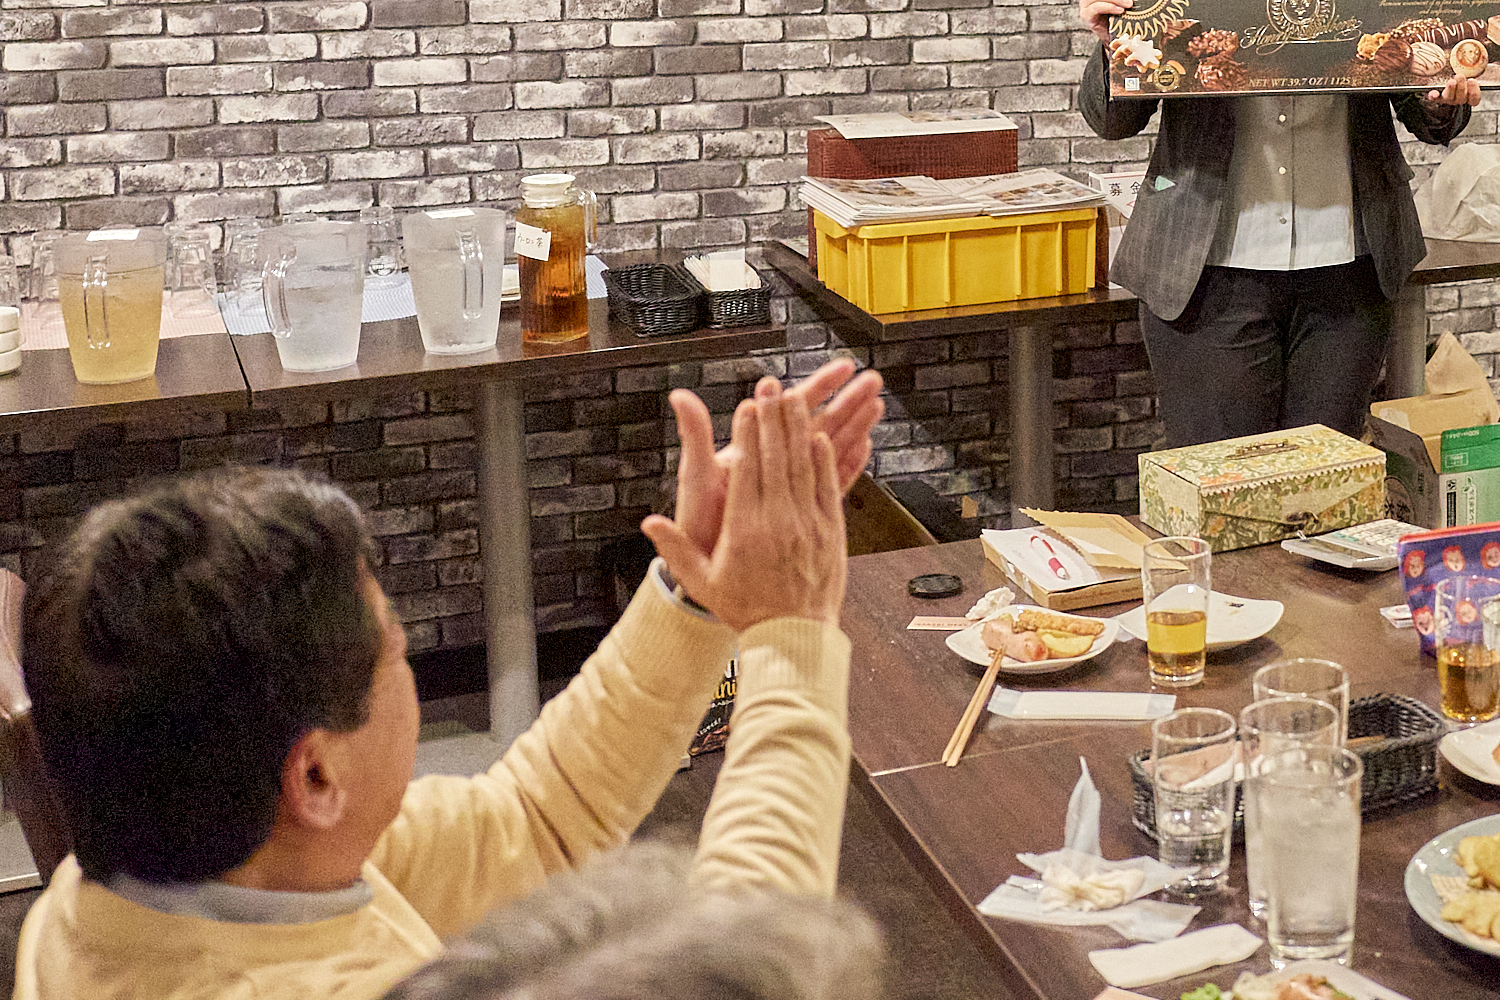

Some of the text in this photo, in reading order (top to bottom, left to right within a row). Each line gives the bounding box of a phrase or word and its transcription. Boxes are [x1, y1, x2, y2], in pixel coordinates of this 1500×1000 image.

[1249, 78, 1268, 88] NET
[1271, 78, 1288, 87] WT
[1288, 77, 1308, 87] 39.7
[1308, 77, 1323, 86] OZ
[1330, 76, 1351, 86] 1125
[1108, 181, 1141, 196] 募金
